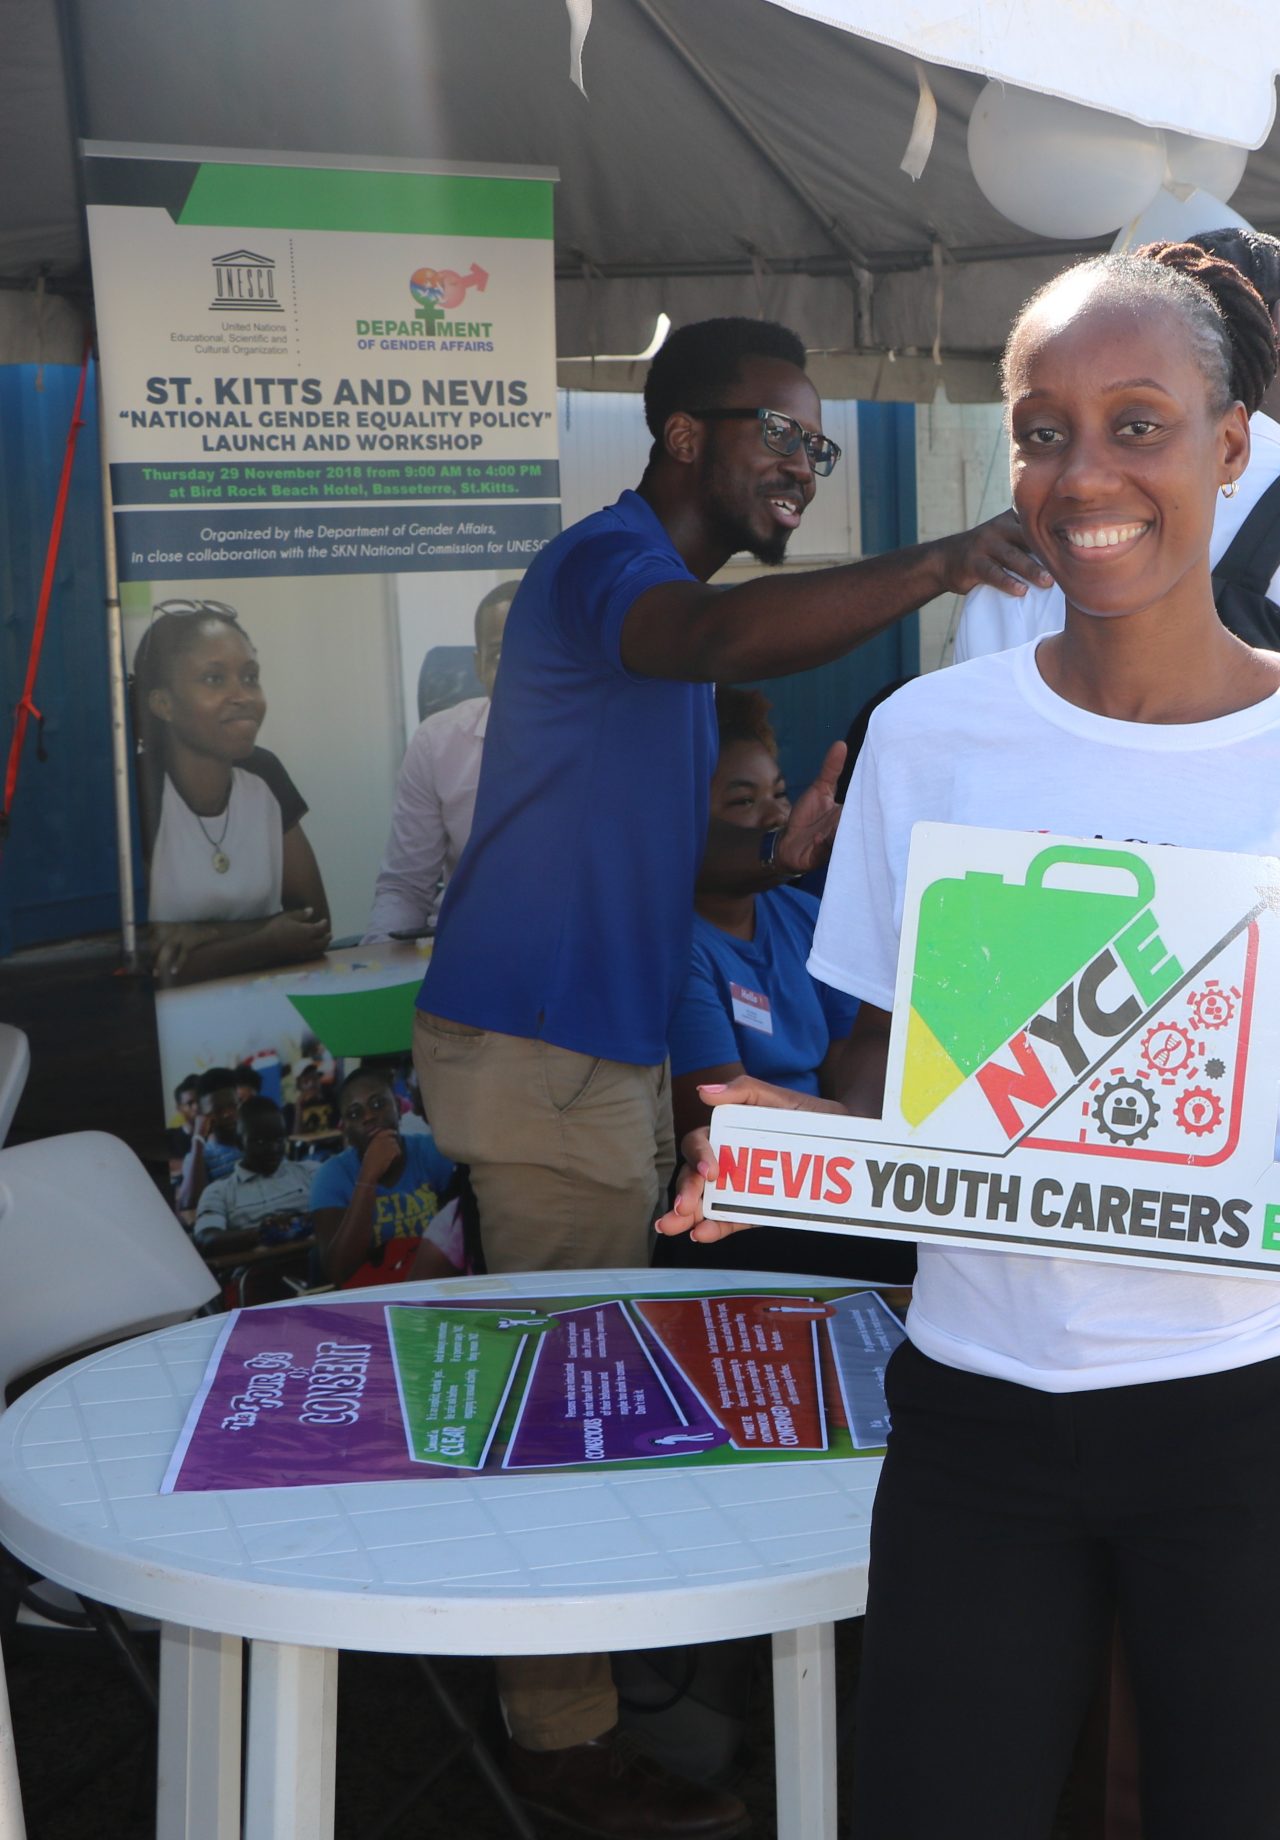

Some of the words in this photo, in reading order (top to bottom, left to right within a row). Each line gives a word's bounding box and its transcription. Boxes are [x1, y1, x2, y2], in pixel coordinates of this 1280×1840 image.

[216, 267, 274, 298] UNESCO
[222, 322, 251, 331] United
[254, 322, 287, 332] Nations
[356, 317, 493, 338] DEPARTMENT
[229, 333, 269, 343] Scientific
[271, 334, 288, 344] and
[357, 339, 375, 350] OF
[380, 340, 436, 351] GENDER
[440, 340, 494, 352] AFFAIRS
[194, 344, 230, 354] Cultural
[232, 345, 288, 356] Organization
[146, 376, 203, 406] ST.
[214, 377, 323, 406] KITTS
[333, 378, 412, 406] AND
[422, 379, 528, 407] NEVIS
[118, 410, 253, 428] “NATIONAL
[258, 410, 350, 428] GENDER
[356, 411, 463, 431] EQUALITY
[469, 411, 552, 428] POLICY”
[202, 434, 296, 452] LAUNCH
[302, 434, 351, 452] AND
[356, 434, 484, 451] WORKSHOP
[142, 468, 215, 483] Thursday
[220, 467, 240, 480] 29
[244, 467, 321, 480] November
[326, 466, 362, 479] 2018
[366, 466, 400, 478] from
[404, 466, 436, 478] 9:00
[440, 465, 462, 478] AM
[466, 466, 481, 477] to
[486, 465, 516, 477] 4:00
[520, 464, 542, 477] PM
[169, 486, 185, 498] at
[190, 485, 222, 498] Bird
[227, 485, 268, 497] Rock
[272, 484, 318, 496] Beach
[324, 483, 368, 496] Hotel,
[372, 483, 457, 496] Basseterre,
[200, 526, 272, 542] Organized
[274, 526, 290, 541] by
[294, 526, 313, 538] the
[317, 525, 389, 540] Department
[392, 524, 407, 536] of
[410, 523, 454, 536] Gender
[457, 523, 496, 536] Affairs,
[131, 552, 144, 564] in
[147, 550, 183, 563] close
[186, 548, 277, 562] collaboration
[280, 546, 304, 558] with
[307, 546, 328, 558] the
[331, 544, 358, 558] SKN
[360, 543, 415, 557] National
[418, 542, 484, 555] Commission
[487, 542, 504, 553] for
[974, 908, 1186, 1141] NYCE
[714, 1144, 856, 1206] NEVIS
[864, 1159, 1022, 1223] YOUTH
[1028, 1177, 1252, 1249] CAREERS
[298, 1342, 372, 1425] CONSENT
[770, 1406, 799, 1445] CONFIRMED
[440, 1426, 466, 1456] CLEAR
[584, 1417, 605, 1459] CONSCIOUS
